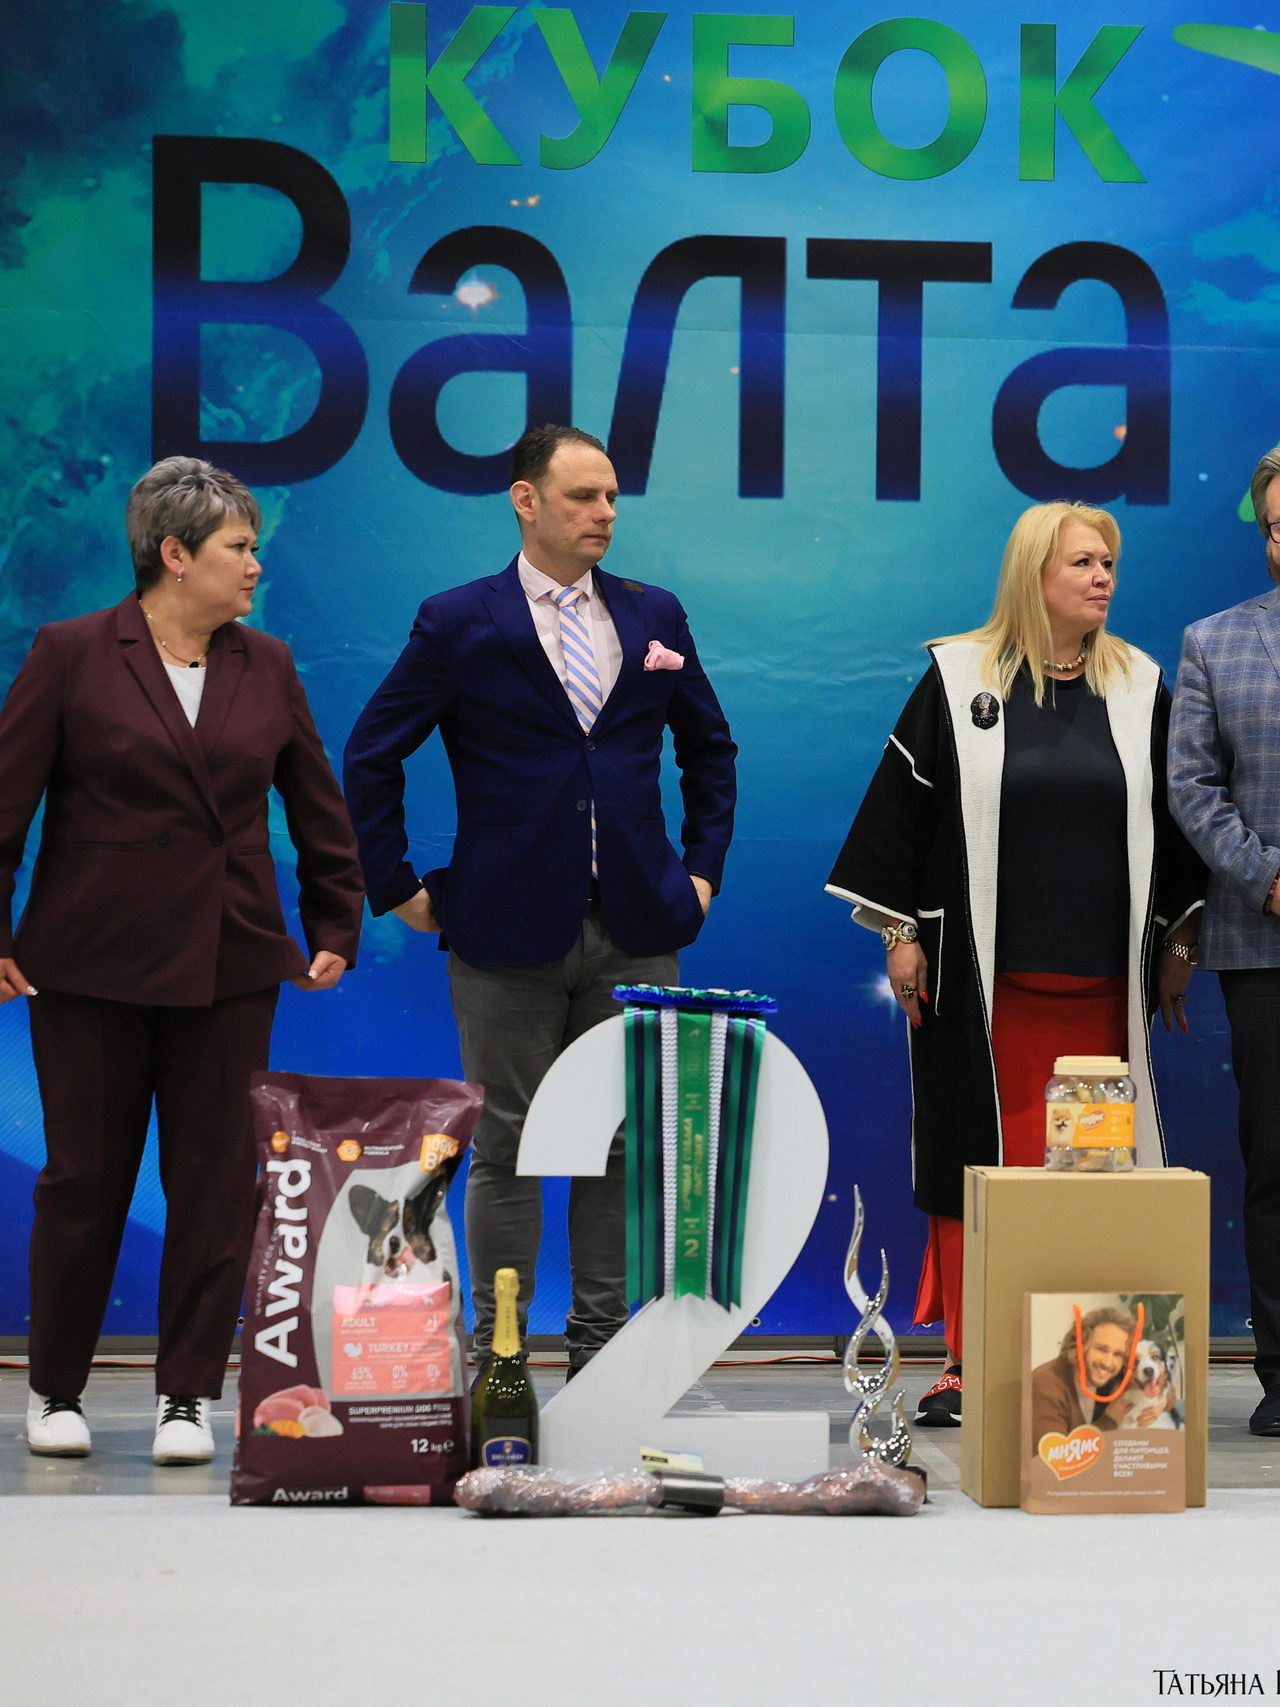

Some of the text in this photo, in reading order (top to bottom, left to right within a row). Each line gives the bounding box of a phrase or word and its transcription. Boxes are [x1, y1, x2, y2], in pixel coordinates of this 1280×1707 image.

[388, 2, 1147, 184] КУБОК
[152, 134, 1172, 506] Валта
[254, 1159, 312, 1369] Award
[272, 1486, 348, 1502] Award
[411, 1438, 429, 1453] 12
